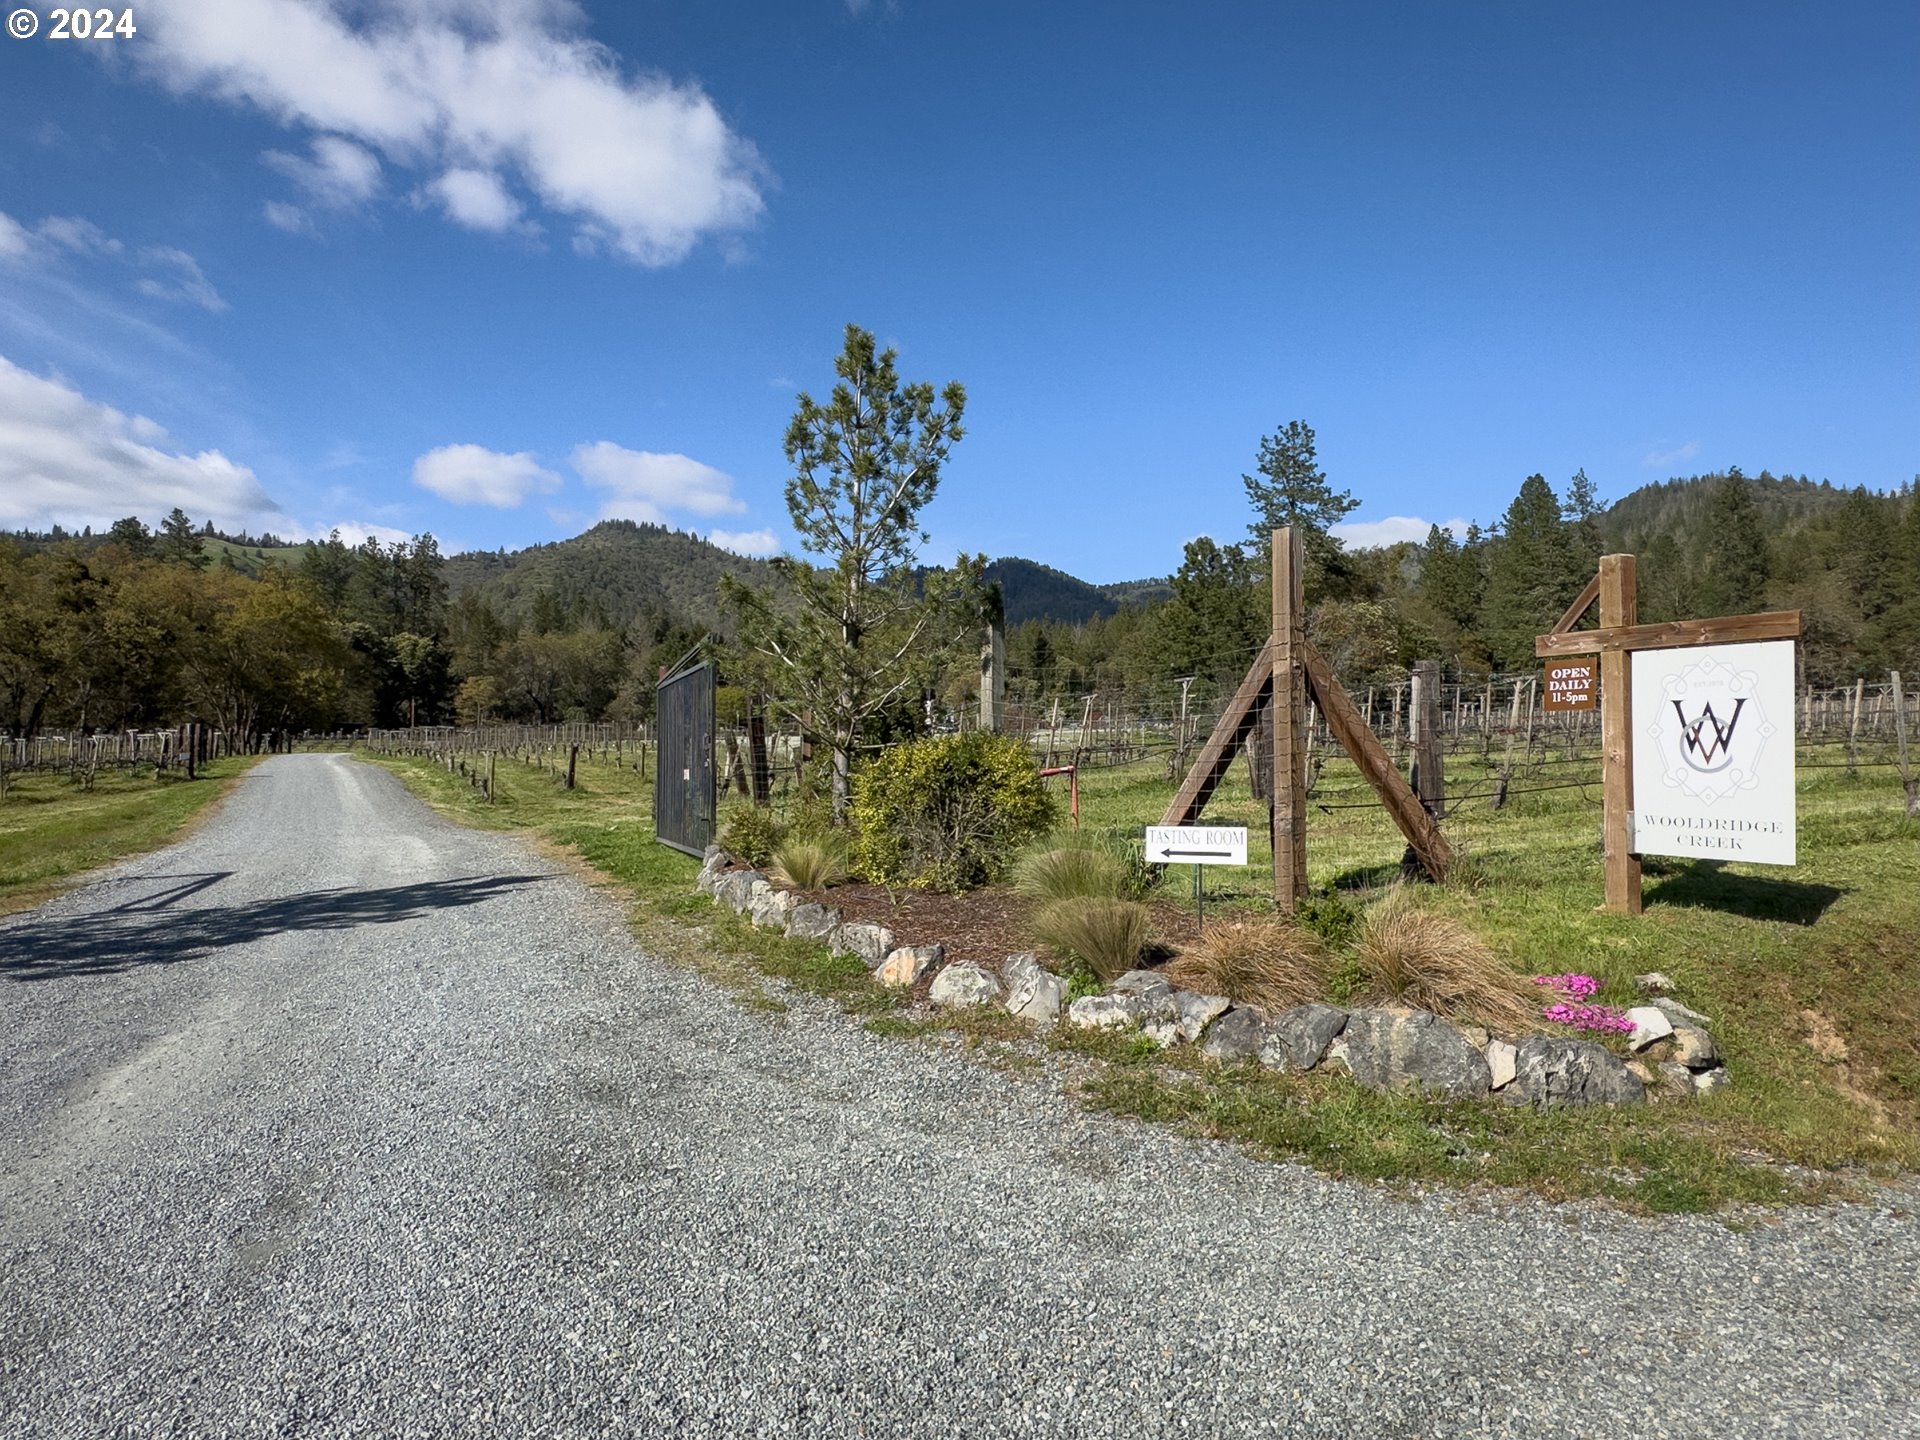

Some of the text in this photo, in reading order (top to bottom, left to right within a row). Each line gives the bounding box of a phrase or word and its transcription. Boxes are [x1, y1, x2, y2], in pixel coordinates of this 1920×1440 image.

[1551, 667, 1591, 679] OPEN
[1549, 679, 1592, 691] DAILY
[1552, 691, 1588, 705] 11-5pm
[1644, 815, 1784, 834] WOOLDRIDGE
[1149, 829, 1244, 846] TASTING ROOM
[1676, 835, 1743, 850] CREEK
